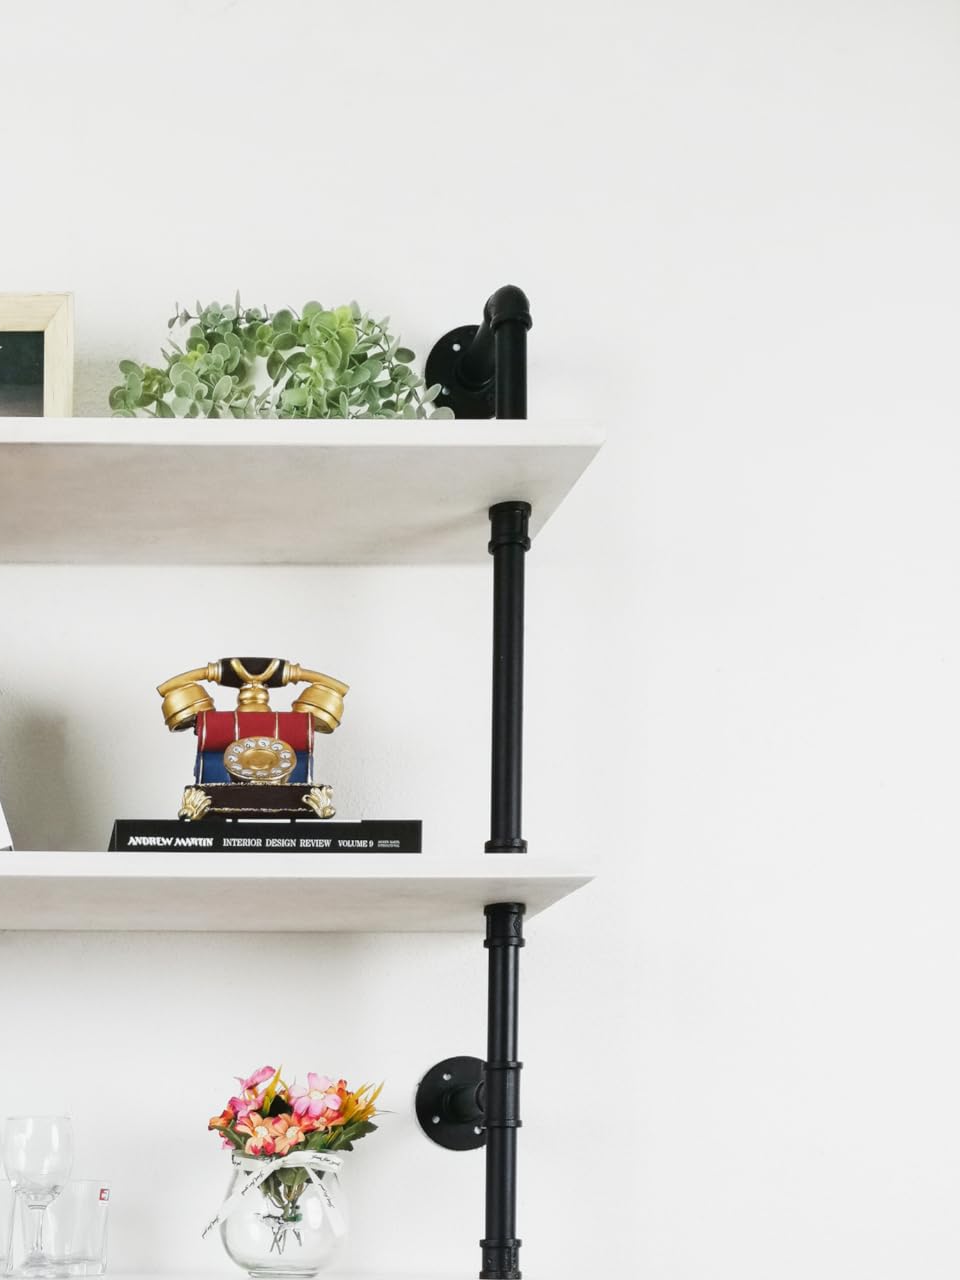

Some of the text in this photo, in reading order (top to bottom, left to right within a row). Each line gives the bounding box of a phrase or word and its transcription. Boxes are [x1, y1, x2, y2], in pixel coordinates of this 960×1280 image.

[127, 836, 173, 847] ANDREW
[174, 837, 214, 847] MARTIN
[222, 838, 262, 847] INTERIOR
[265, 839, 297, 848] DESIGN
[299, 839, 332, 848] REVIEW
[338, 840, 368, 848] VOLUME
